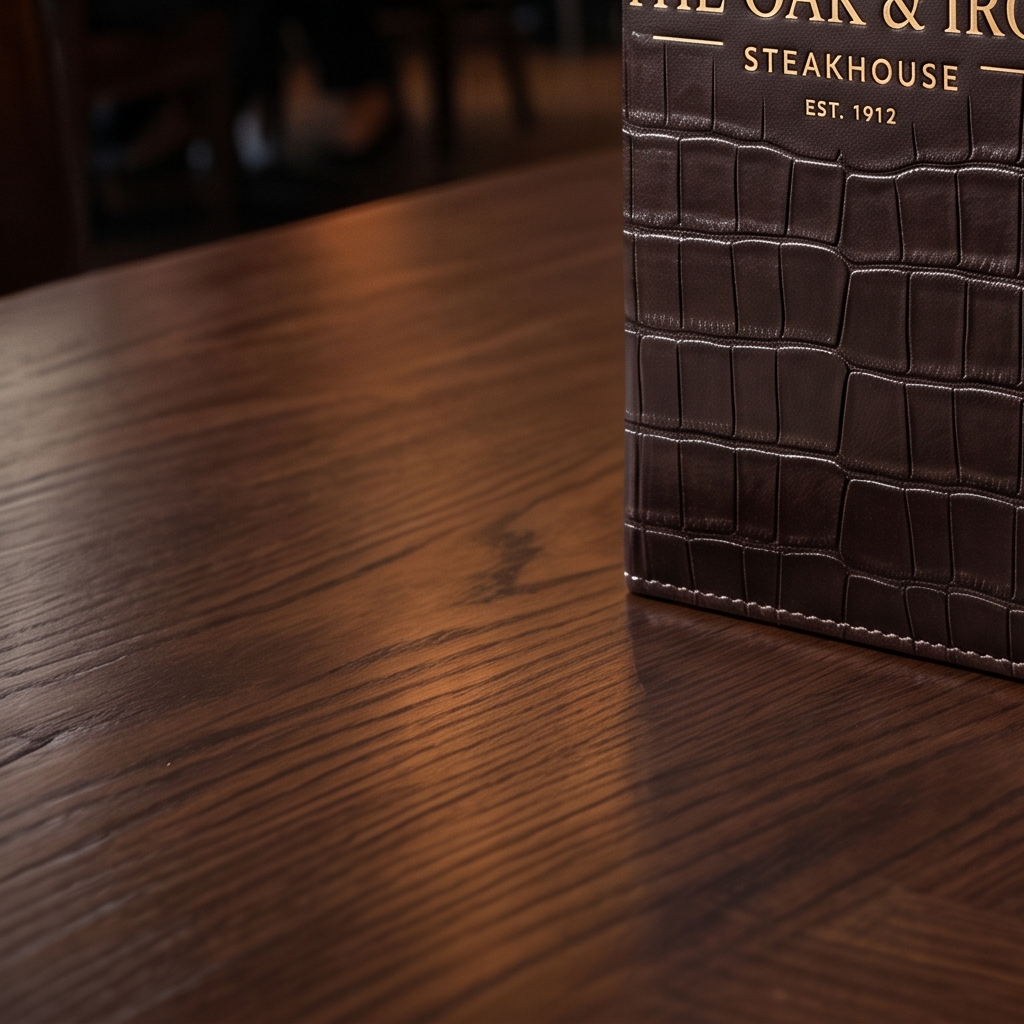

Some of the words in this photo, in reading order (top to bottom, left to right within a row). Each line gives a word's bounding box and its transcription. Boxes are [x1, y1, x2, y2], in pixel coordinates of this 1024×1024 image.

[743, 45, 959, 92] STEAKHOUSE
[805, 98, 845, 120] EST.
[853, 104, 897, 125] 1912
